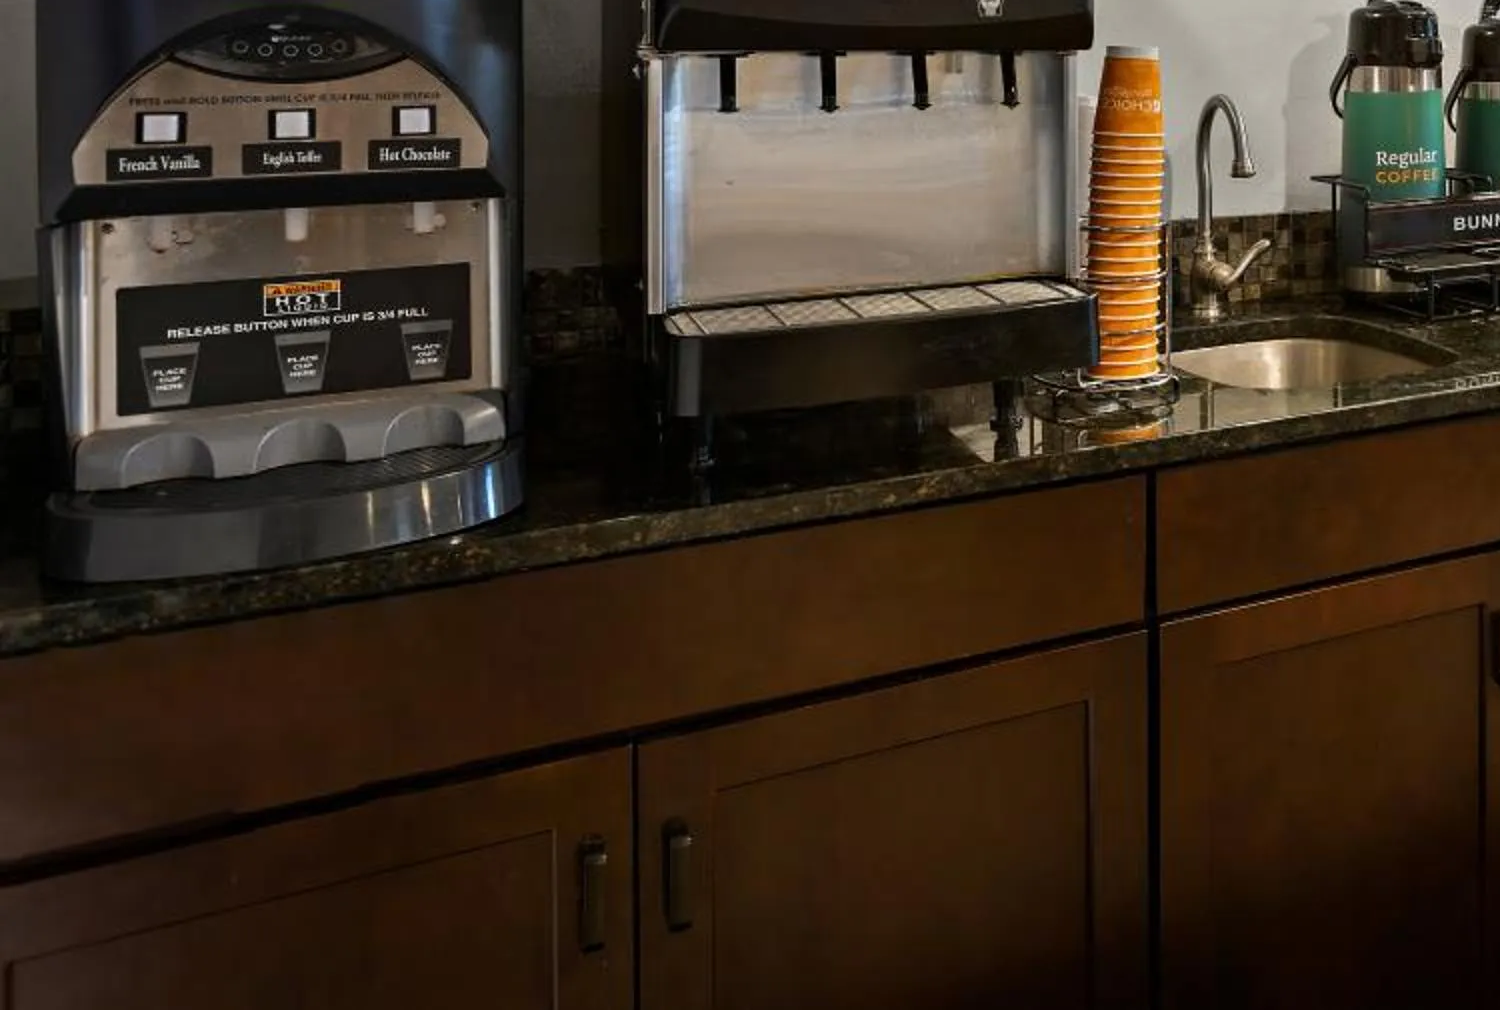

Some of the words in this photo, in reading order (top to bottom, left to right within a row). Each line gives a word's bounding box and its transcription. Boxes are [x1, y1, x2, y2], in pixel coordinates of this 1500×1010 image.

[263, 151, 295, 168] English
[297, 150, 322, 164] Toffee
[379, 147, 400, 162] Hot
[401, 146, 451, 161] Chocolate
[1376, 147, 1438, 169] Regular
[119, 157, 159, 173] French
[160, 154, 201, 171] Vanilla
[1375, 168, 1439, 184] COFFEE
[275, 292, 330, 307] HOT
[167, 323, 231, 339] RELEASE
[234, 319, 288, 333] BUTTON
[291, 315, 330, 328] WHEN
[333, 313, 360, 324] CUP
[363, 311, 376, 322] IS
[377, 309, 395, 321] 3/4
[397, 307, 429, 318] FULL
